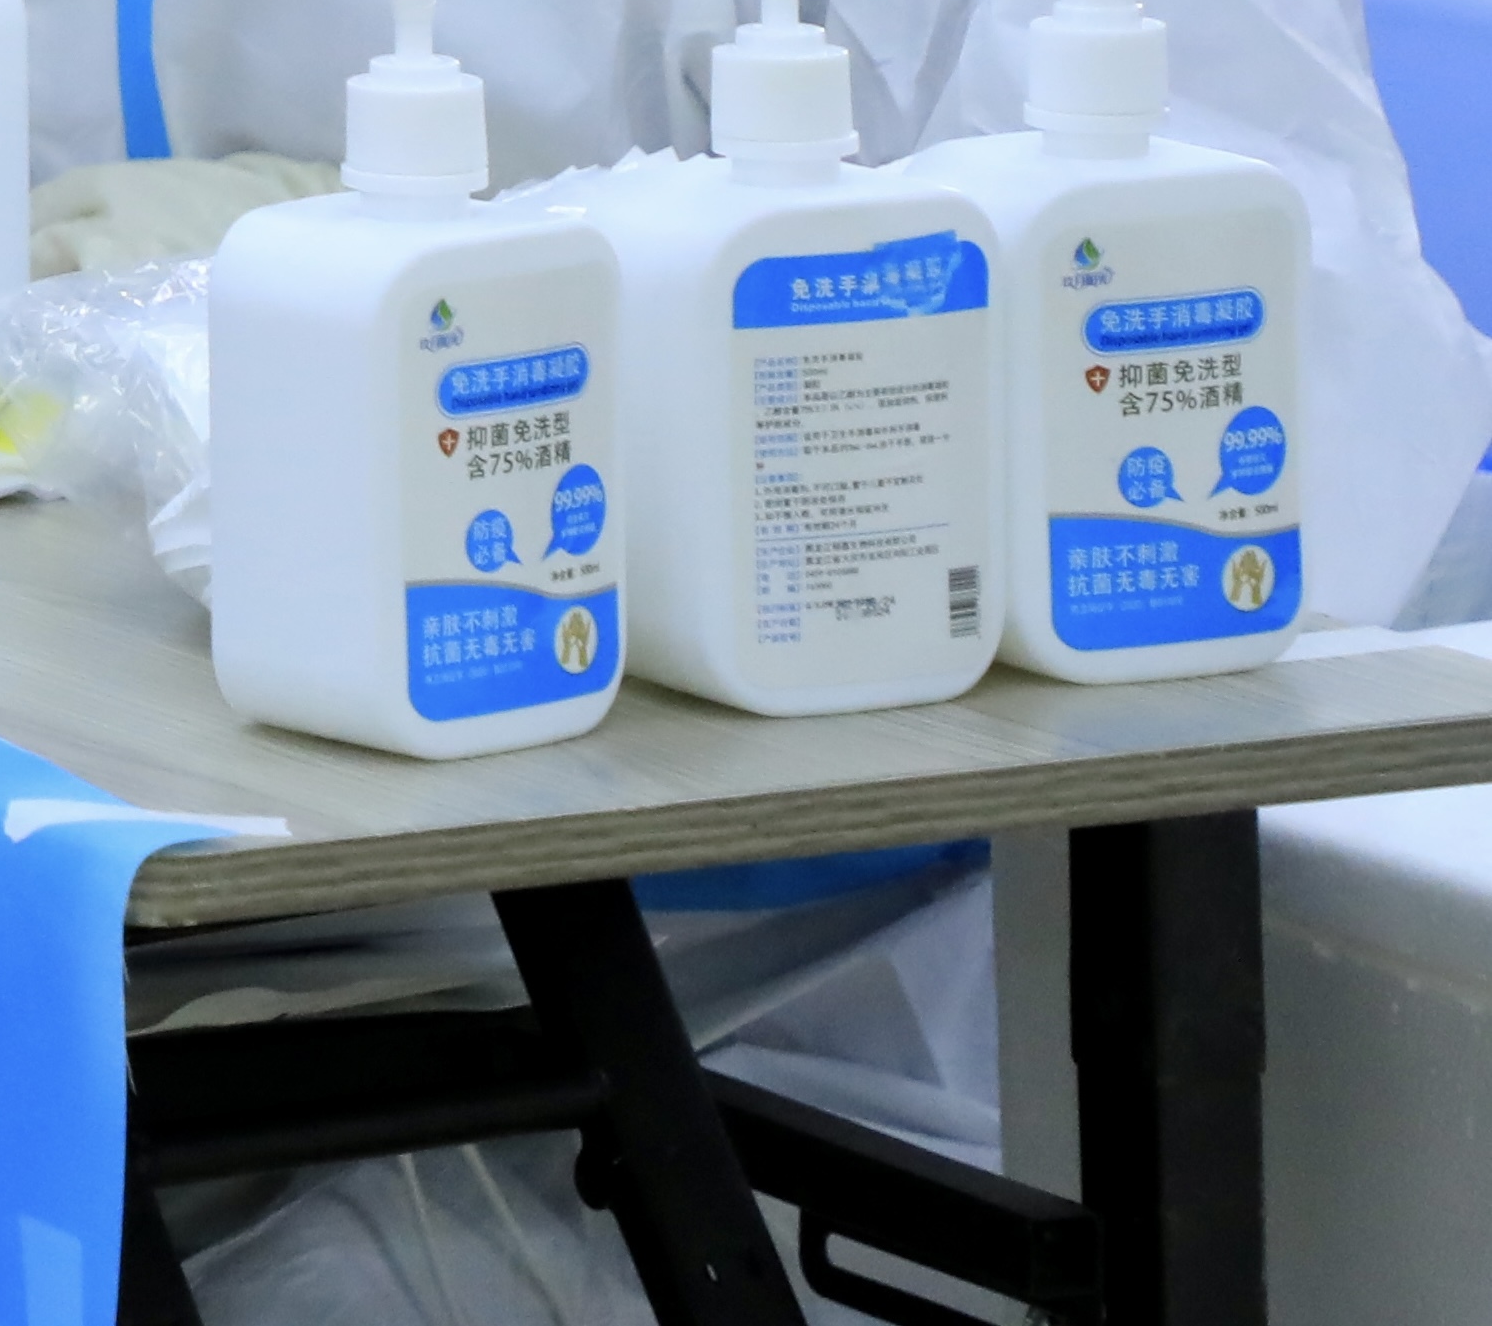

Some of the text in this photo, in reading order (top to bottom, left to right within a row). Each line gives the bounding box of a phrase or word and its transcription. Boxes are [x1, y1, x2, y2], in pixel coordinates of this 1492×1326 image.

[1099, 296, 1254, 334] 免洗手消毒凝胶
[451, 351, 580, 395] 免洗手消毒凝胶
[1118, 353, 1242, 389] 抑菌免洗型
[1119, 381, 1244, 417] 含75%酒精
[466, 410, 570, 451] 抑菌免洗型
[1224, 426, 1283, 453] 99.99%
[467, 440, 571, 481] 含75%酒精
[1127, 454, 1166, 477] 防疫
[554, 484, 604, 513] 99.99%
[1067, 540, 1179, 570] 亲肤不刺激
[1068, 564, 1200, 597] 抗菌无毒无害
[423, 627, 536, 667] 抗菌无毒无害
